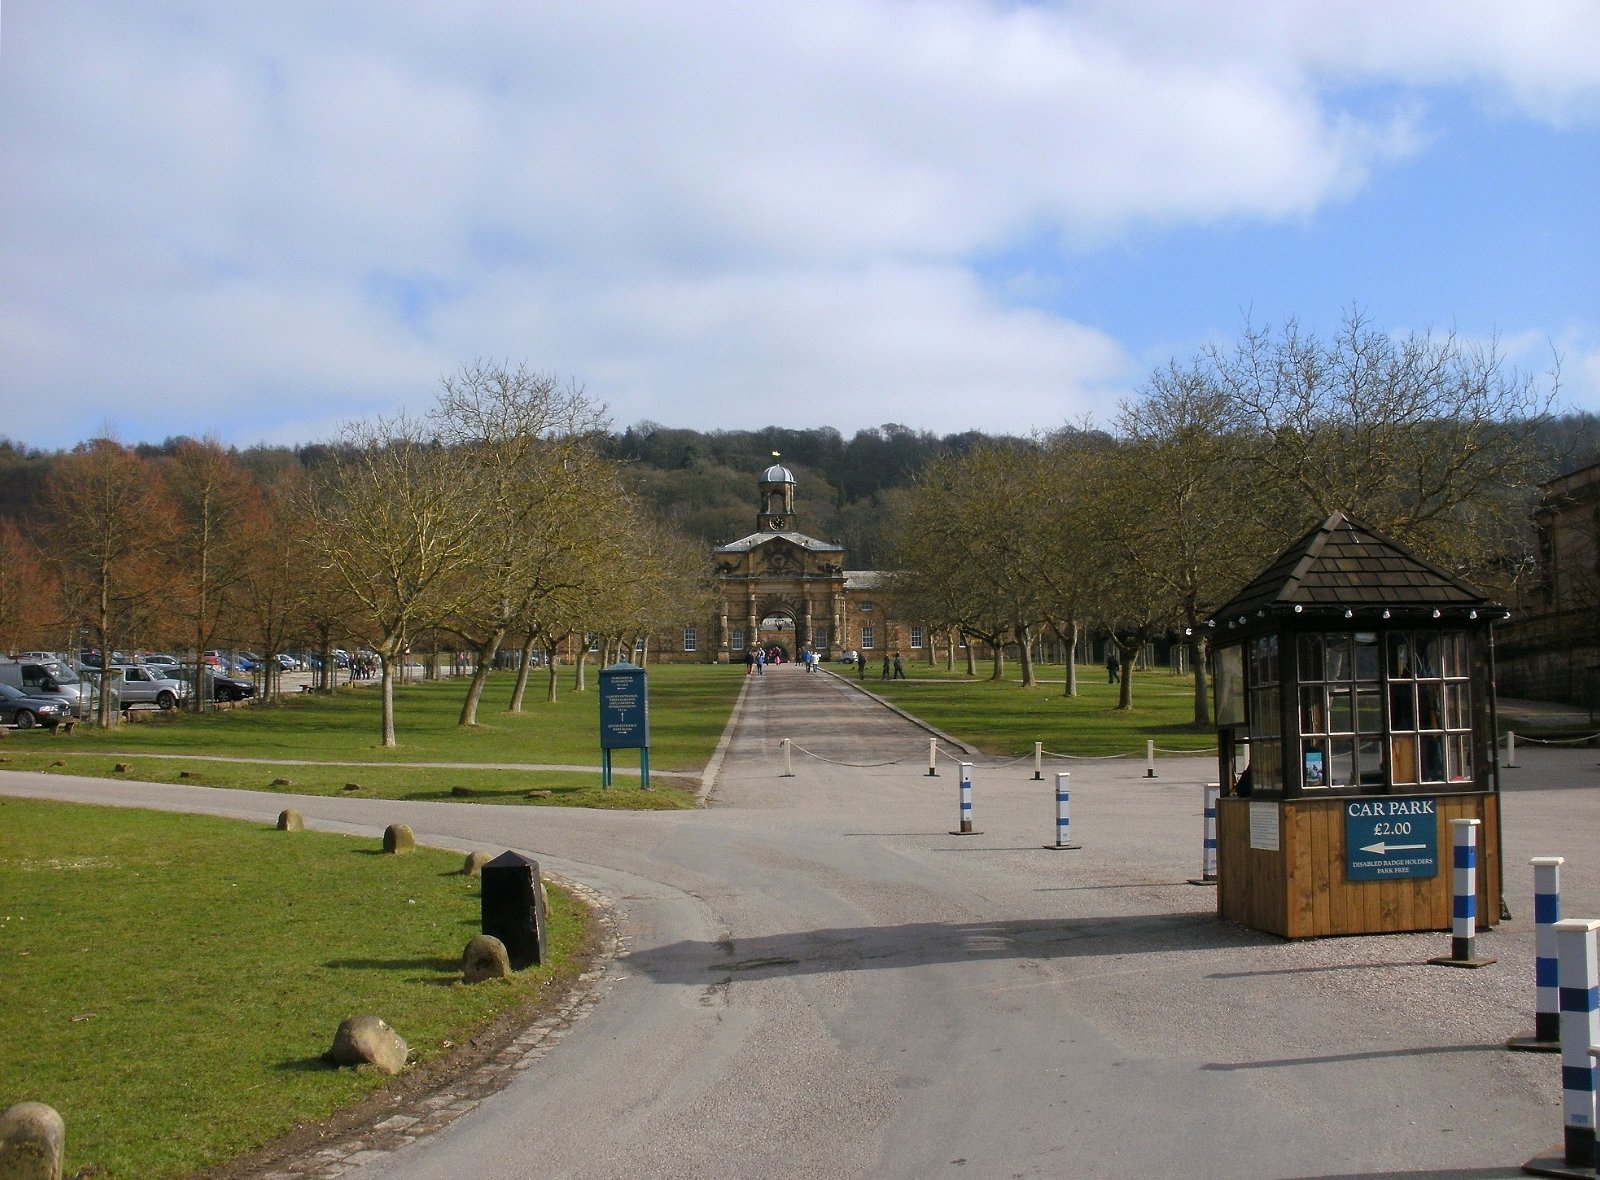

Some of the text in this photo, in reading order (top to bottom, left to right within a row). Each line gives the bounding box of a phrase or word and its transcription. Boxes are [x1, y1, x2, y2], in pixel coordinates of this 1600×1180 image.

[1348, 800, 1435, 817] CAR PARK
[1374, 822, 1411, 836] £2.00
[1383, 859, 1404, 867] BADGE
[1404, 858, 1433, 866] HOLDERS
